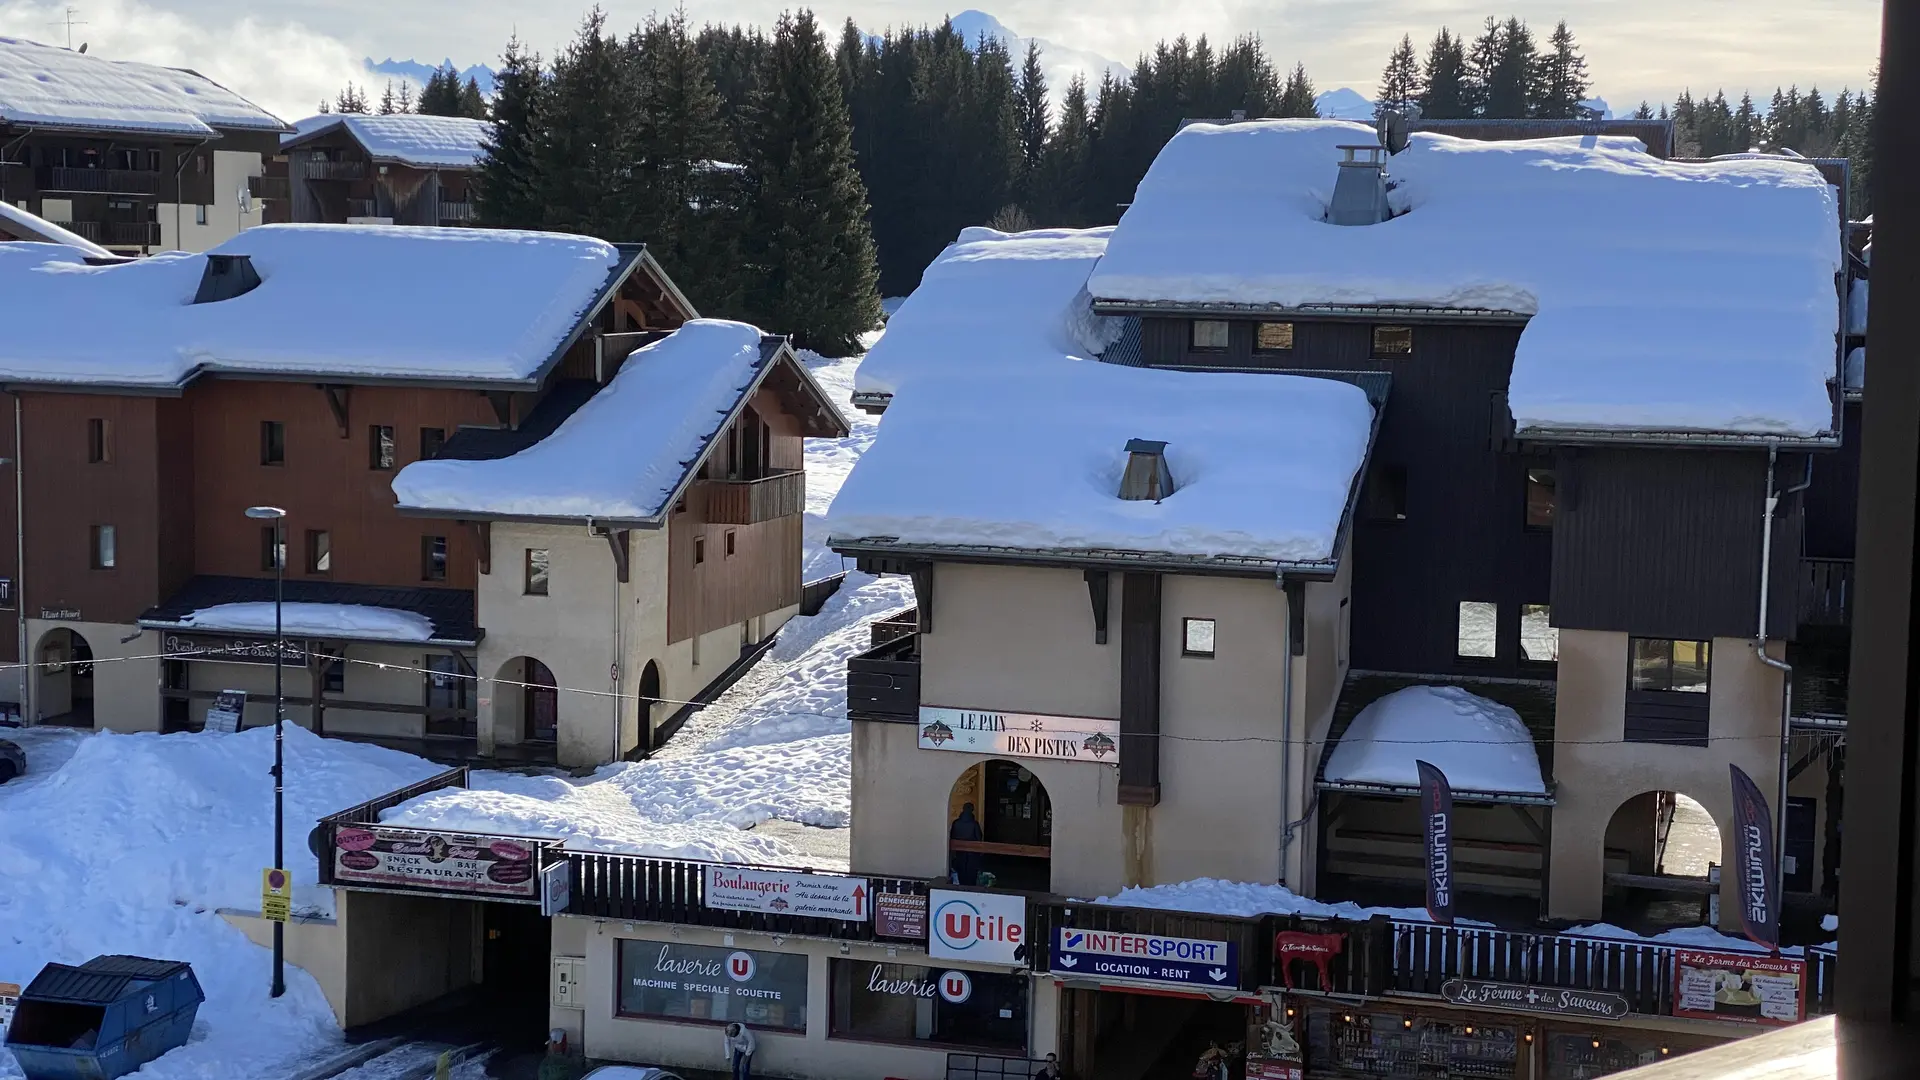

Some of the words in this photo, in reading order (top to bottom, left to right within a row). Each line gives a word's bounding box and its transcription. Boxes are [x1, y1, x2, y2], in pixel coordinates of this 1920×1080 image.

[251, 642, 302, 660] Savoarde
[960, 713, 976, 730] LE
[980, 714, 1007, 732] PAIN
[1008, 736, 1030, 754] DES
[1034, 738, 1077, 758] PISTES
[386, 856, 421, 864] SNACK
[387, 865, 484, 880] RESTAURANT
[712, 870, 790, 898] Boulangerie
[832, 894, 841, 902] de
[794, 904, 818, 912] galerie
[818, 906, 853, 914] marchande
[945, 913, 1022, 943] Utile
[1086, 933, 1218, 962] INTERSPORT
[654, 944, 720, 977] laverie
[732, 958, 748, 976] U
[1692, 954, 1705, 964] La
[1706, 955, 1734, 967] Ferme
[1736, 958, 1750, 968] des
[1752, 960, 1788, 972] Saveurs
[866, 964, 936, 997] laverie
[946, 978, 963, 996] U
[1095, 962, 1150, 976] LOCATION
[1161, 966, 1190, 980] RENT
[633, 978, 677, 990] MACHINE
[684, 982, 730, 995] SPECIALE
[736, 988, 781, 1000] COUETTE
[1458, 983, 1477, 1002] La
[1480, 984, 1522, 1002] Ferme
[1540, 992, 1555, 1004] des
[1558, 991, 1613, 1015] Saveurs
